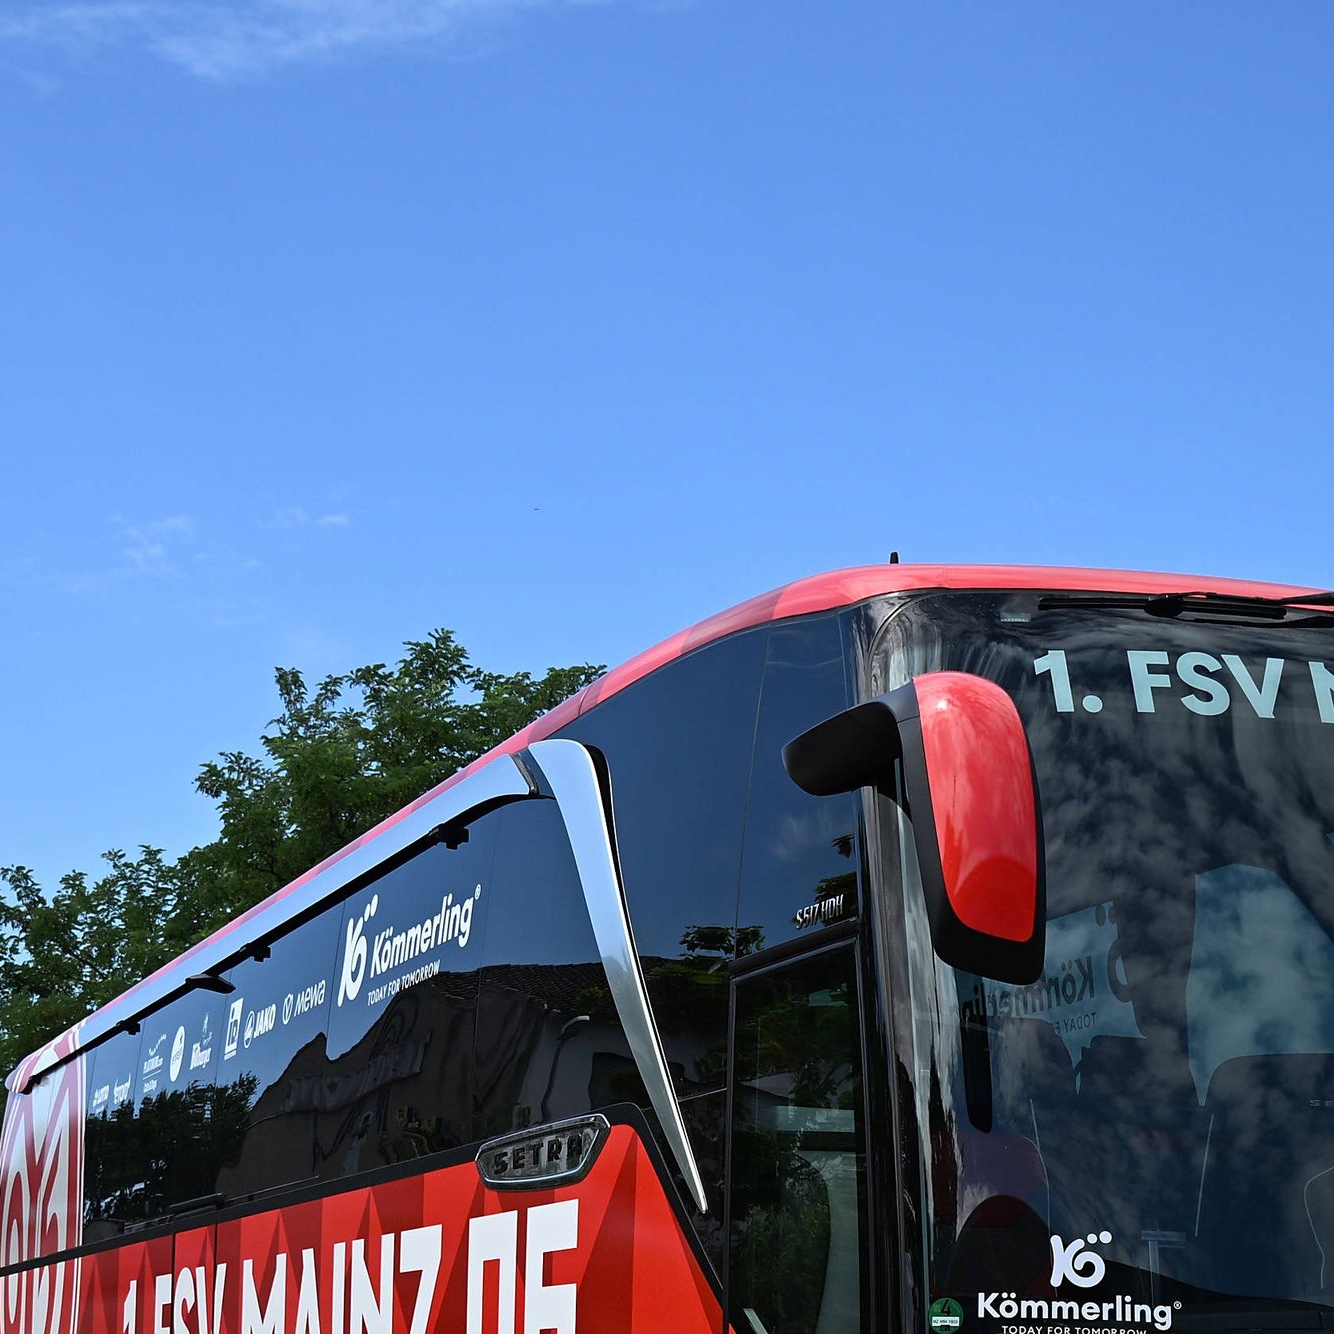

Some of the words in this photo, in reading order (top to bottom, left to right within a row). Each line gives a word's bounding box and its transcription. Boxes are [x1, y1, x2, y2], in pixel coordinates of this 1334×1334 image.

[1034, 650, 1102, 713] 1.
[1128, 651, 1284, 719] FSV
[368, 984, 388, 1006] TODAY
[388, 978, 401, 997] FOR
[401, 959, 441, 990] TOMORROW
[253, 1003, 277, 1039] JAKO
[494, 1133, 583, 1175] SETRA
[941, 1299, 951, 1316] 4
